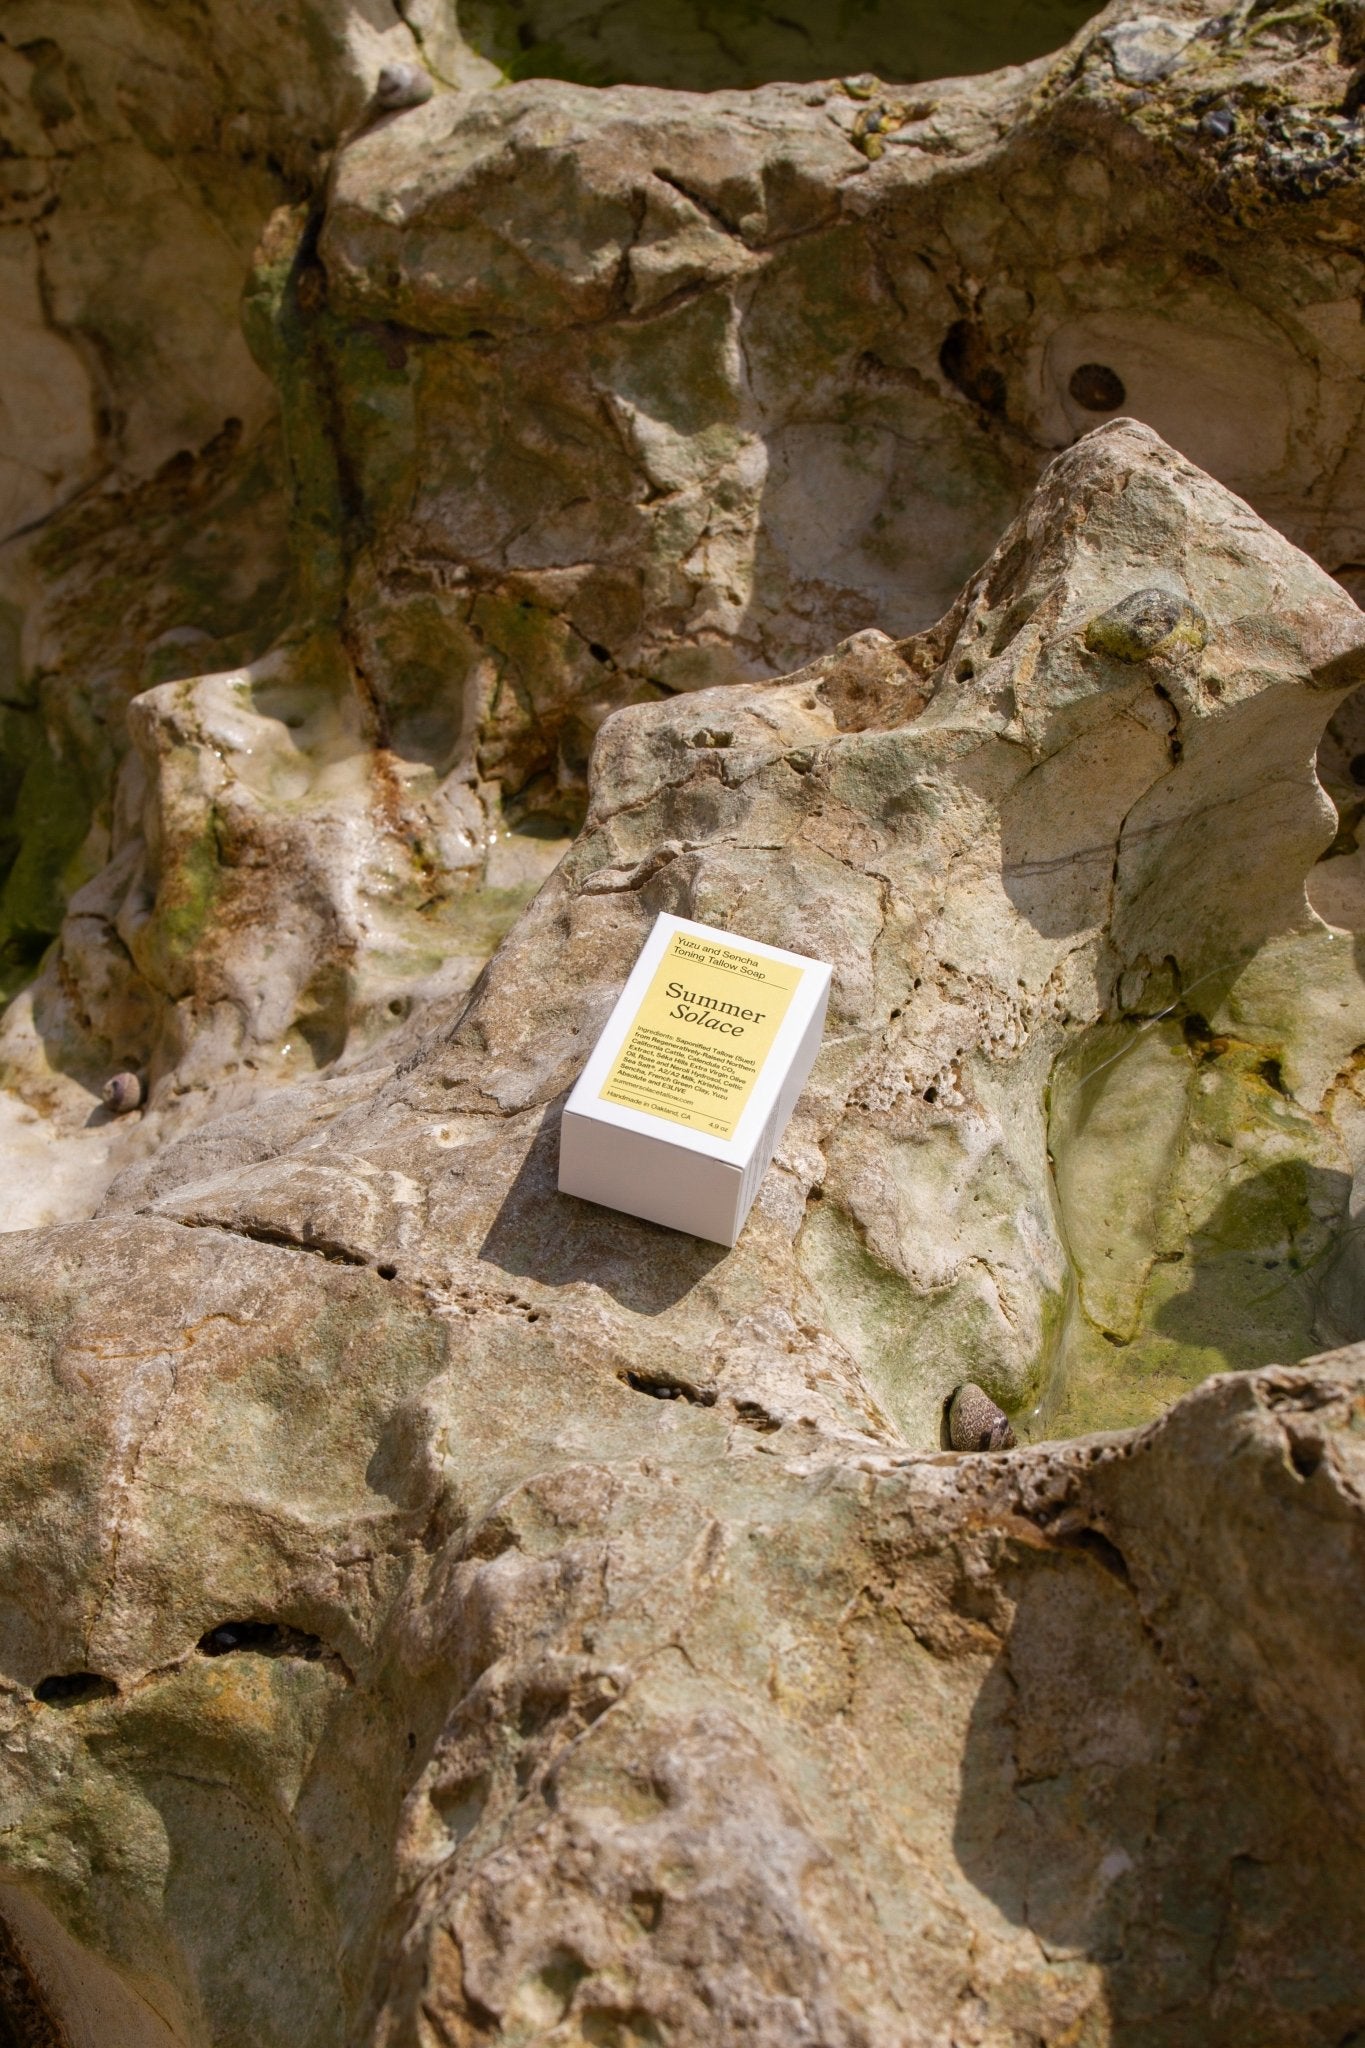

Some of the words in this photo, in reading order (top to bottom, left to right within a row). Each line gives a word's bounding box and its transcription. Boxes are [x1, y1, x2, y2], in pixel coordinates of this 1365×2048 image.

[674, 945, 705, 963] Toning
[708, 955, 739, 973] Tallow
[739, 965, 766, 980] Soap
[678, 936, 701, 950] Yuzu
[701, 946, 722, 956] and
[721, 950, 759, 967] Sencha
[665, 982, 766, 1024] Summer
[668, 1003, 745, 1037] Solace
[631, 1037, 663, 1052] California
[687, 1054, 720, 1069] Calendula
[634, 1031, 651, 1040] from
[726, 1059, 756, 1073] Northern
[675, 1036, 712, 1052] Saponified
[712, 1047, 734, 1059] Tallow
[734, 1055, 756, 1066] (Suet)
[616, 1069, 647, 1082] Absolute
[622, 1056, 636, 1065] Sea
[657, 1067, 681, 1078] A2/A2
[697, 1079, 728, 1093] Kirishima
[637, 1053, 655, 1063] Rose
[669, 1063, 690, 1073] Neroli
[723, 1080, 743, 1091] Celtic
[647, 1071, 671, 1082] French
[672, 1078, 693, 1089] Green
[712, 1090, 728, 1100] Yuzu
[673, 1057, 688, 1066] Hills
[689, 1062, 708, 1072] Extra
[709, 1068, 728, 1078] Virgin
[729, 1075, 746, 1084] Olive
[606, 1090, 642, 1105] Handmade
[680, 1112, 691, 1120] CA
